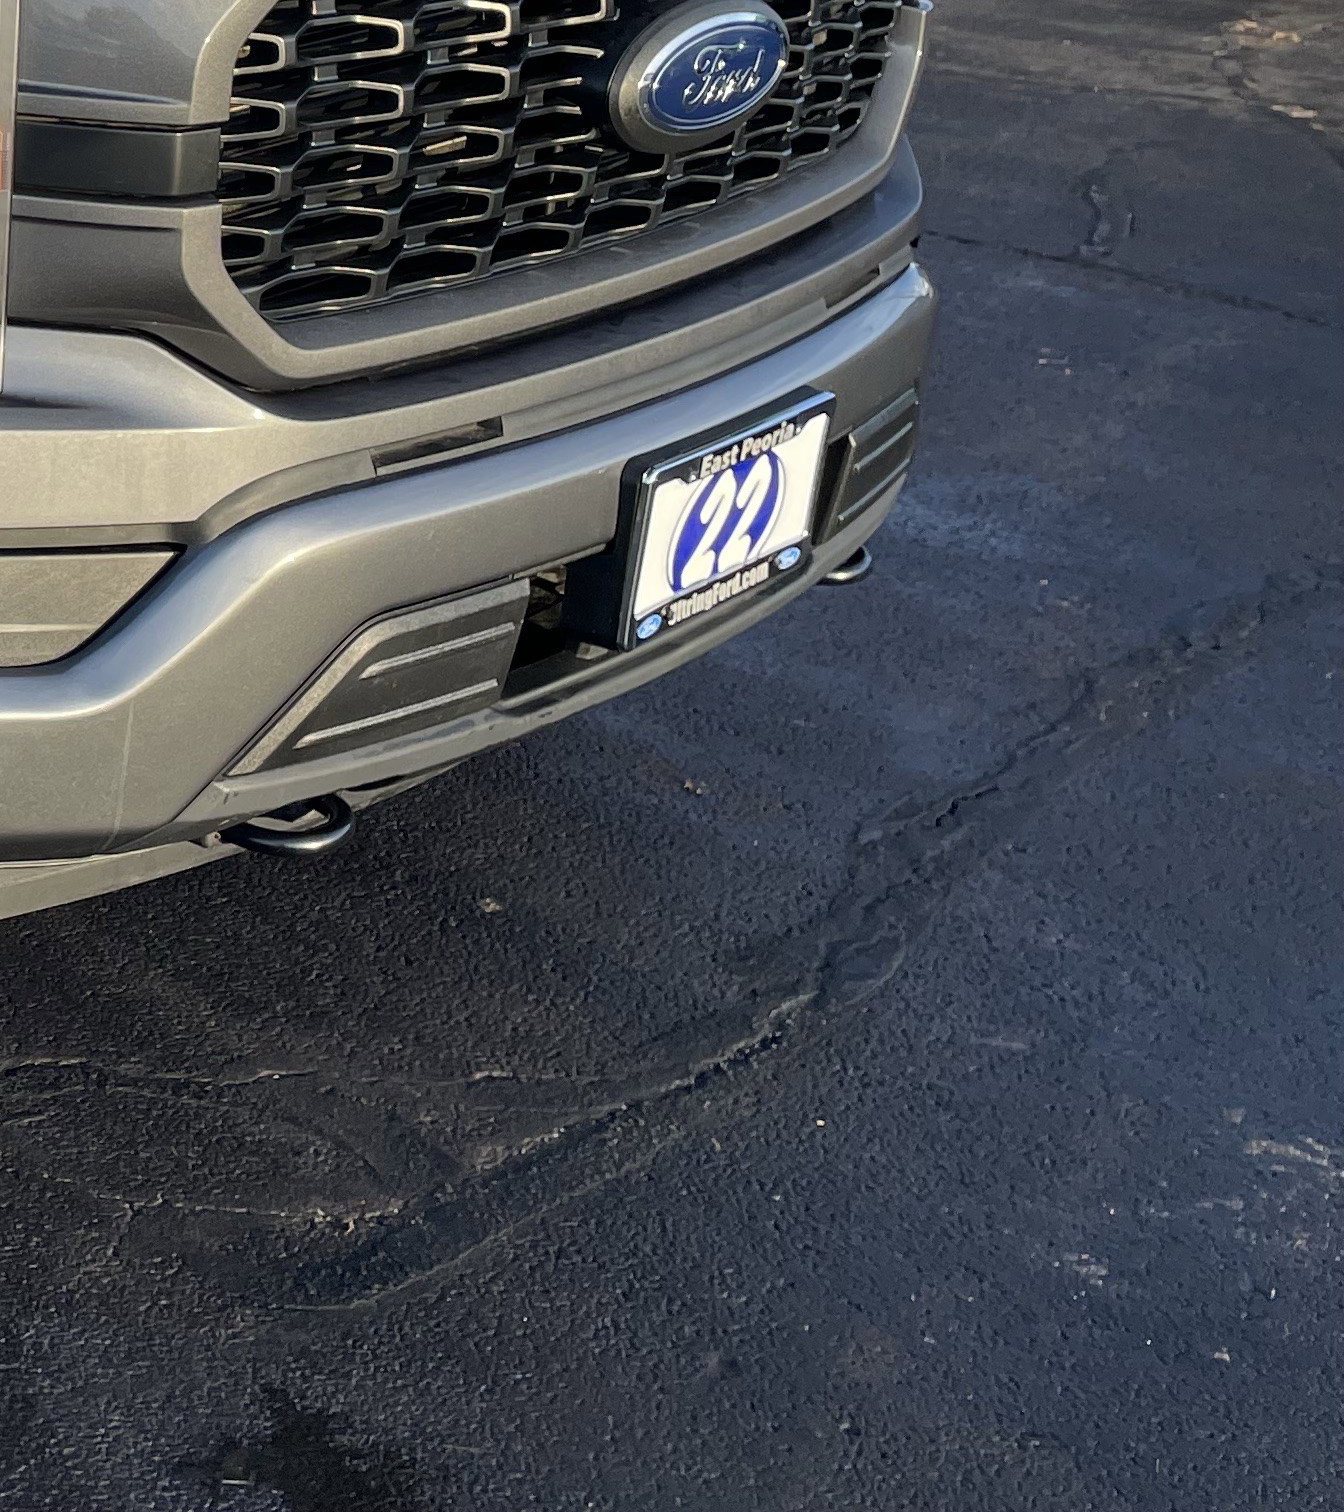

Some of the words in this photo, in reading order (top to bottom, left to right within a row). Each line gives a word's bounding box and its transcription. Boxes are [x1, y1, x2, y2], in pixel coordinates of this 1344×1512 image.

[683, 41, 765, 112] Ford
[700, 445, 740, 478] East
[740, 420, 796, 461] Peoria
